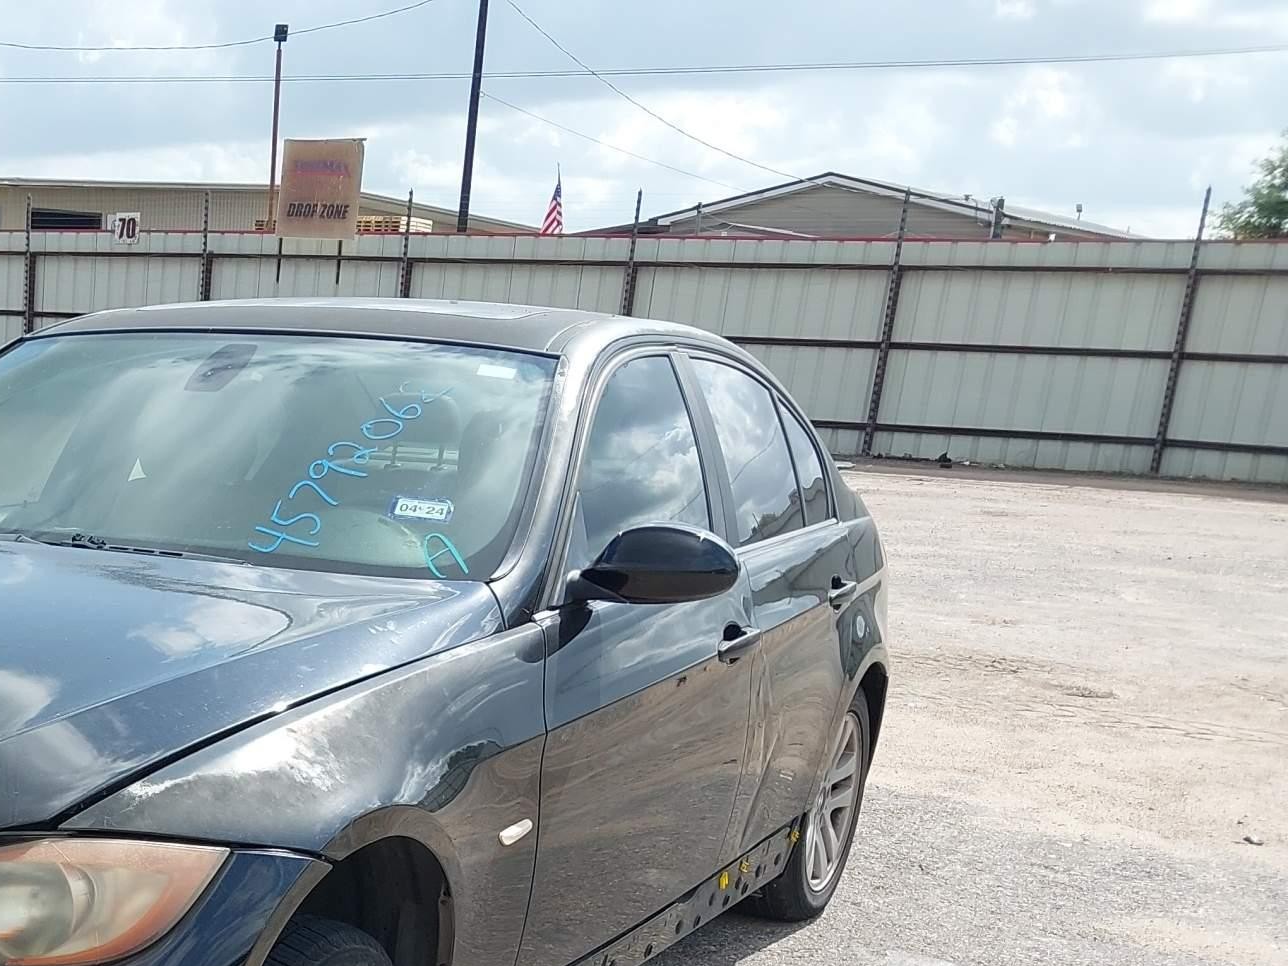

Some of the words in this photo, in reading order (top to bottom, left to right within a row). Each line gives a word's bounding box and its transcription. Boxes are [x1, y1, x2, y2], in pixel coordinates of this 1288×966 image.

[287, 203, 318, 217] DROP
[319, 204, 350, 219] ZONE
[118, 217, 137, 240] 70
[424, 533, 469, 578] A
